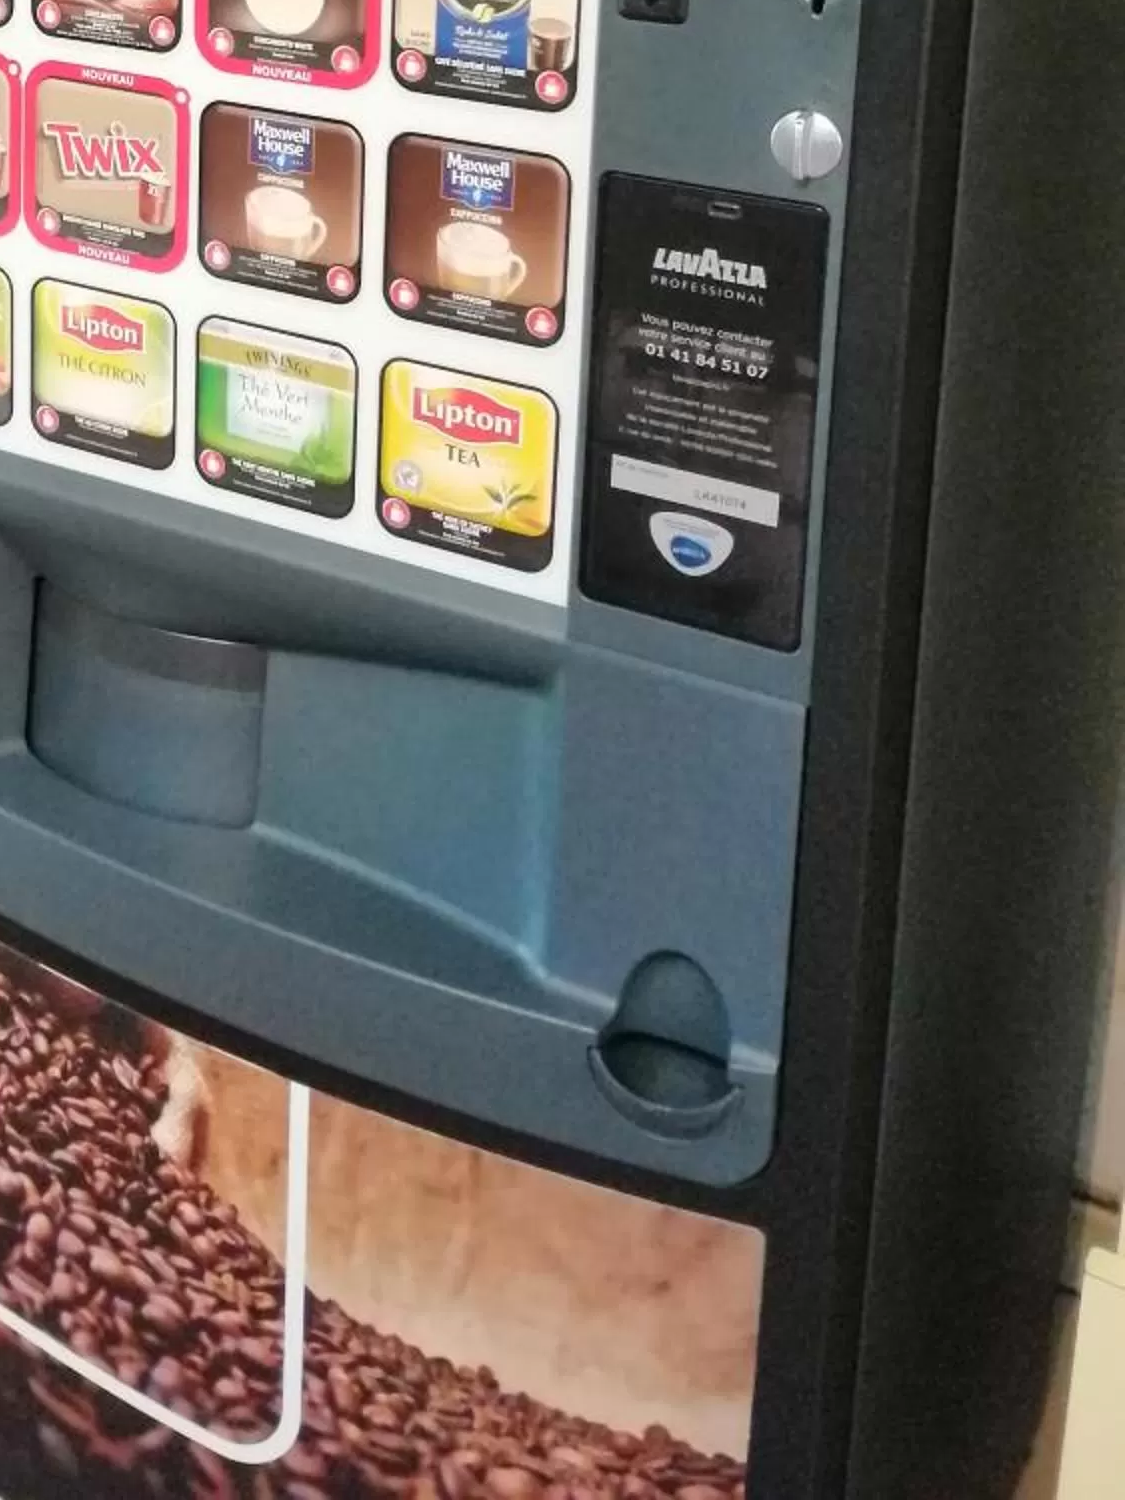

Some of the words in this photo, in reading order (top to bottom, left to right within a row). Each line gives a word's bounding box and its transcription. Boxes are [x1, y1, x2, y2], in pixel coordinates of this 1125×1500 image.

[82, 67, 135, 88] NOUVEAU
[252, 64, 312, 82] NOUVEAU
[254, 120, 310, 145] Maxwell
[258, 136, 304, 157] House
[446, 151, 510, 178] Maxwell
[451, 169, 503, 192] House
[78, 245, 130, 264] NOUVEAU
[652, 247, 768, 289] LAVAZZA
[650, 274, 765, 307] PROFESSIONAL
[67, 308, 138, 344] Lipton
[672, 321, 714, 337] pouvez
[645, 343, 665, 358] 01
[670, 348, 690, 363] 41
[695, 353, 717, 369] 84
[721, 358, 742, 375] 51
[746, 364, 769, 379] 07
[88, 360, 147, 389] CITRON
[420, 392, 513, 435] Lipton
[445, 443, 481, 469] TEA
